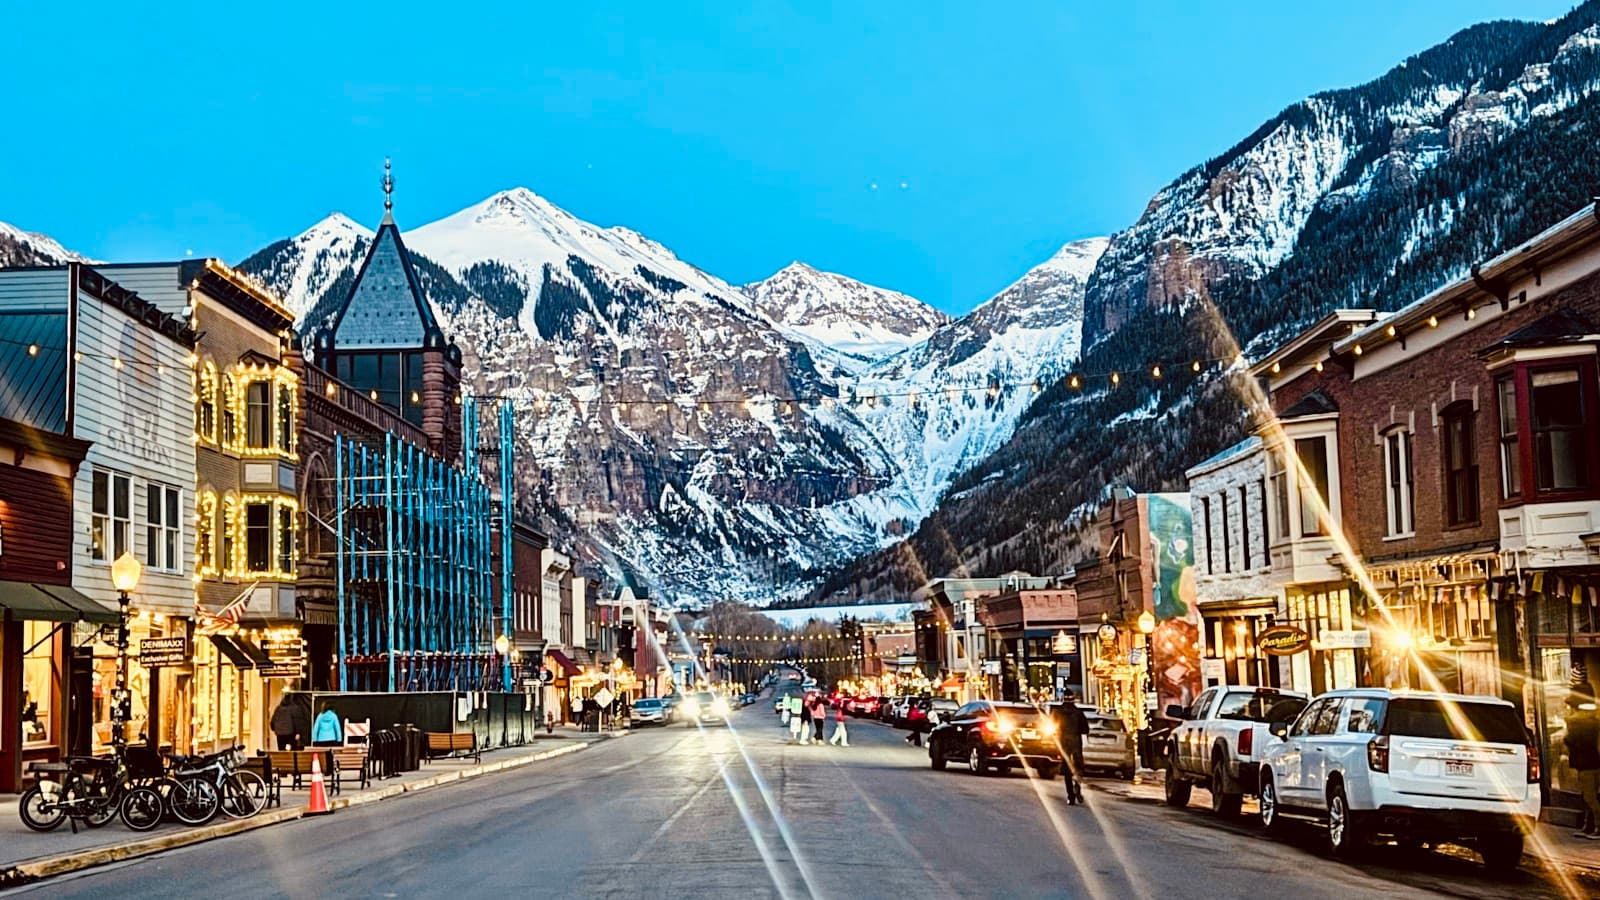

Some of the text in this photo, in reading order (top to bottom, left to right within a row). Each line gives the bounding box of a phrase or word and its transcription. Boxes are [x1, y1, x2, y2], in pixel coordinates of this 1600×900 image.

[107, 428, 172, 467] SALOON
[141, 640, 184, 649] DENIMAXX
[1259, 633, 1307, 648] Paradise
[141, 653, 184, 663] Exclusive Gifts
